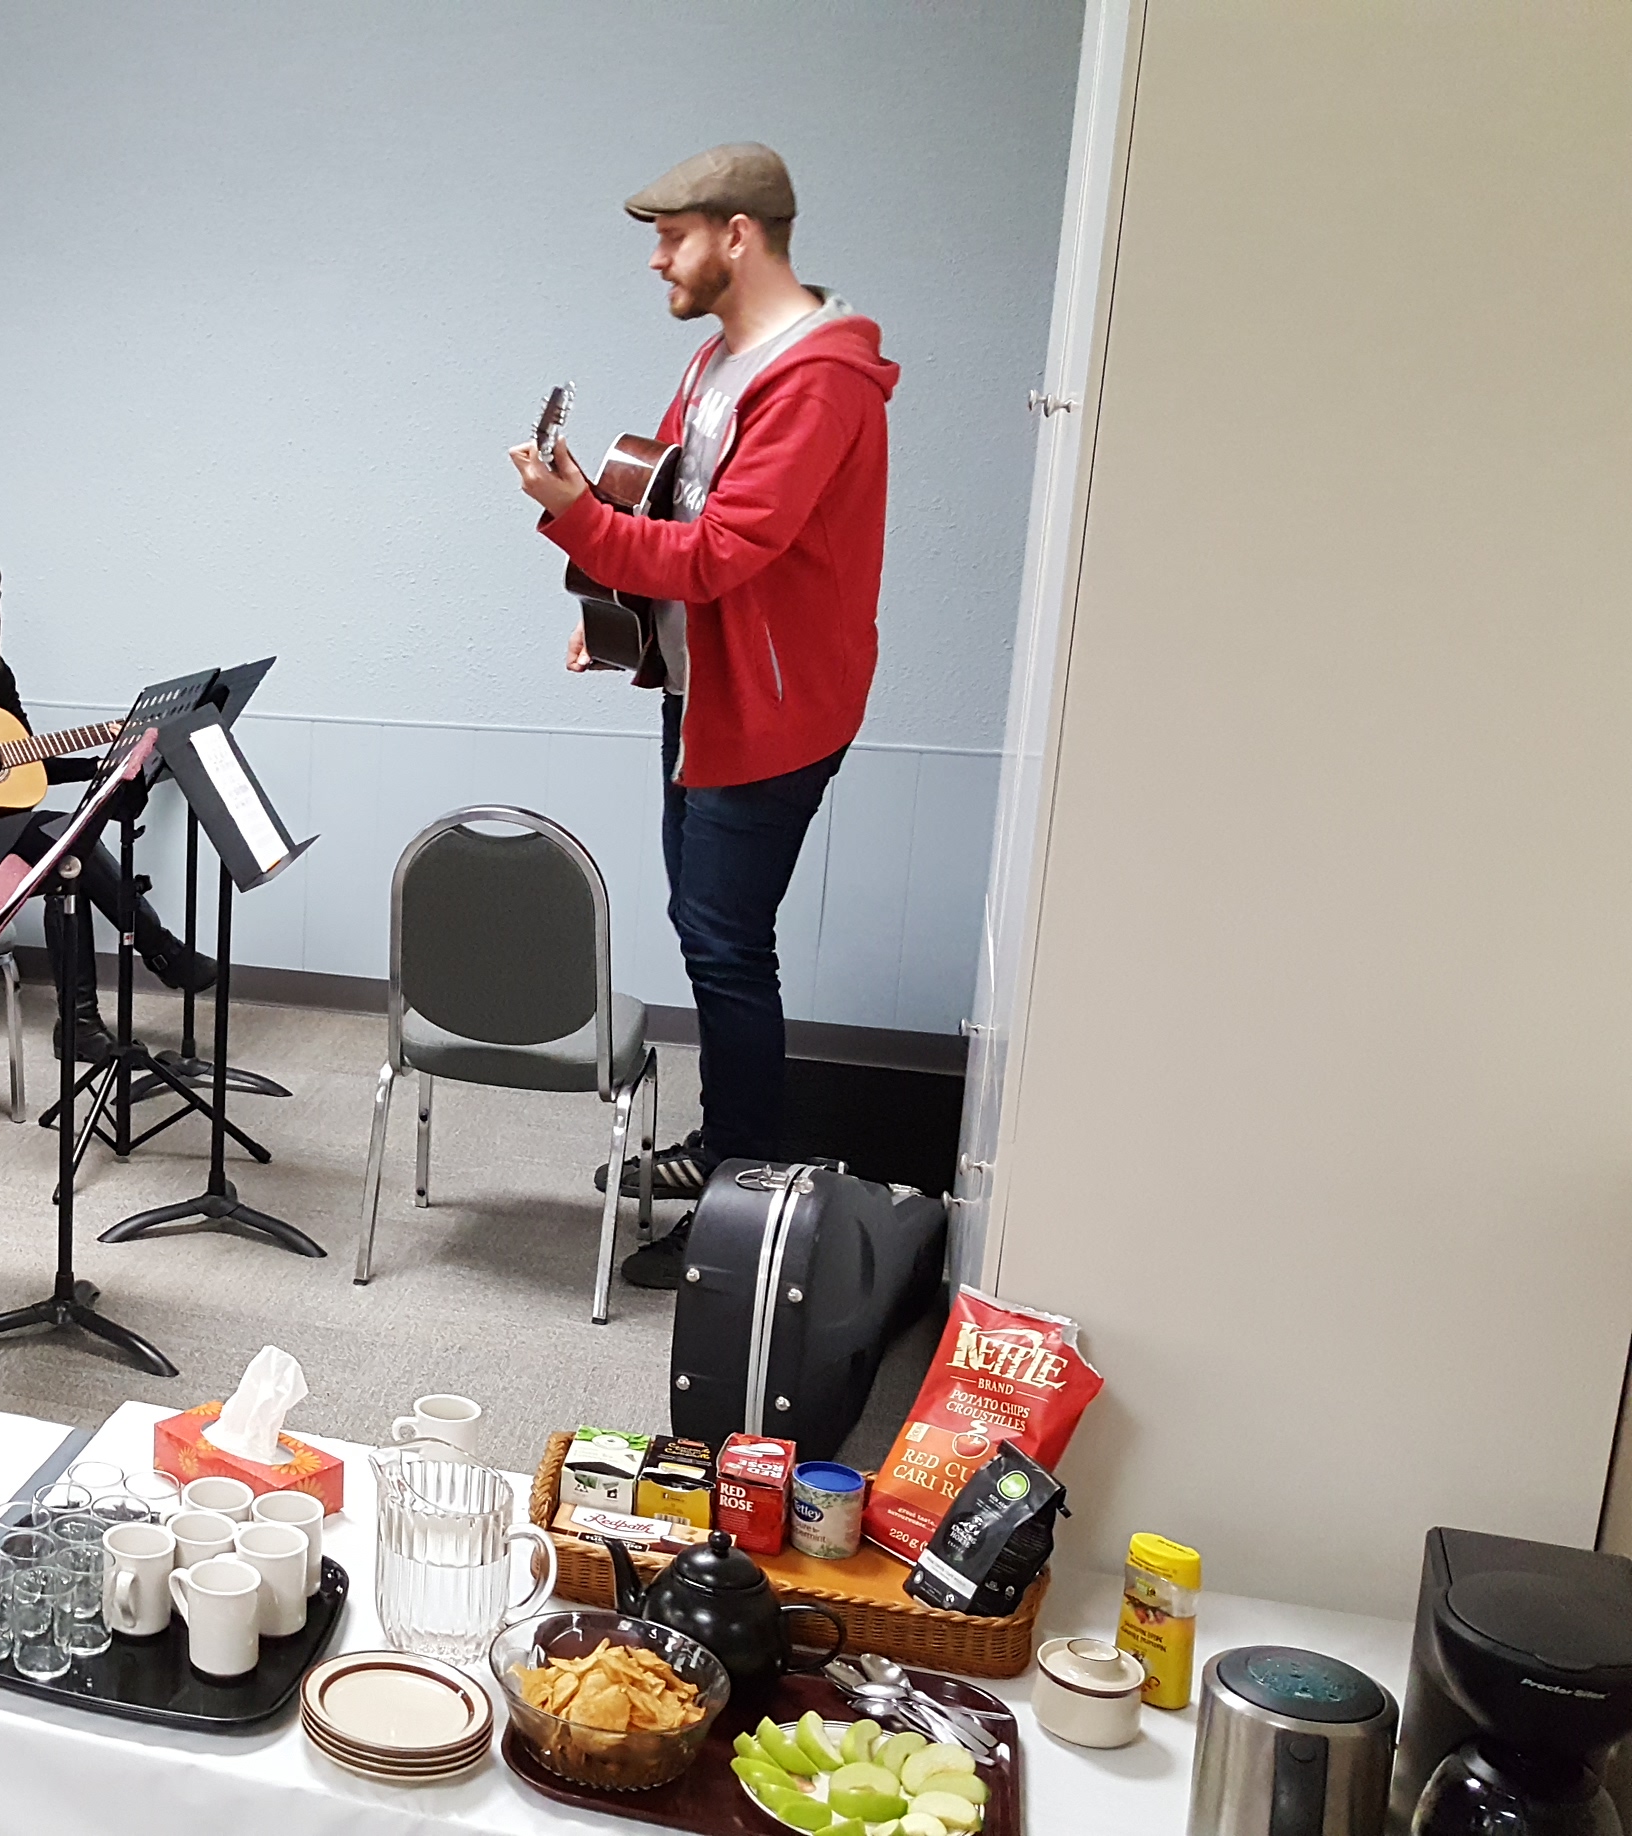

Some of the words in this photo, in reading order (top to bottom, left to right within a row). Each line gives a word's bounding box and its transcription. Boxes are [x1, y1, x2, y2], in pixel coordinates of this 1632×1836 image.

[946, 1321, 1068, 1389] KETTLE
[978, 1378, 1014, 1395] BRAND
[950, 1389, 999, 1411] POTATO
[1000, 1401, 1030, 1419] CHIPS
[946, 1401, 1026, 1432] CROUSTILLES
[738, 1459, 784, 1472] ROSE
[901, 1449, 939, 1469] RED
[746, 1467, 782, 1479] RED
[893, 1464, 939, 1491] CARI
[720, 1482, 746, 1498] RED
[719, 1494, 754, 1512] ROSE
[583, 1513, 655, 1535] Redpath
[889, 1528, 909, 1543] 220
[909, 1538, 919, 1549] g
[1520, 1678, 1573, 1694] Proctor
